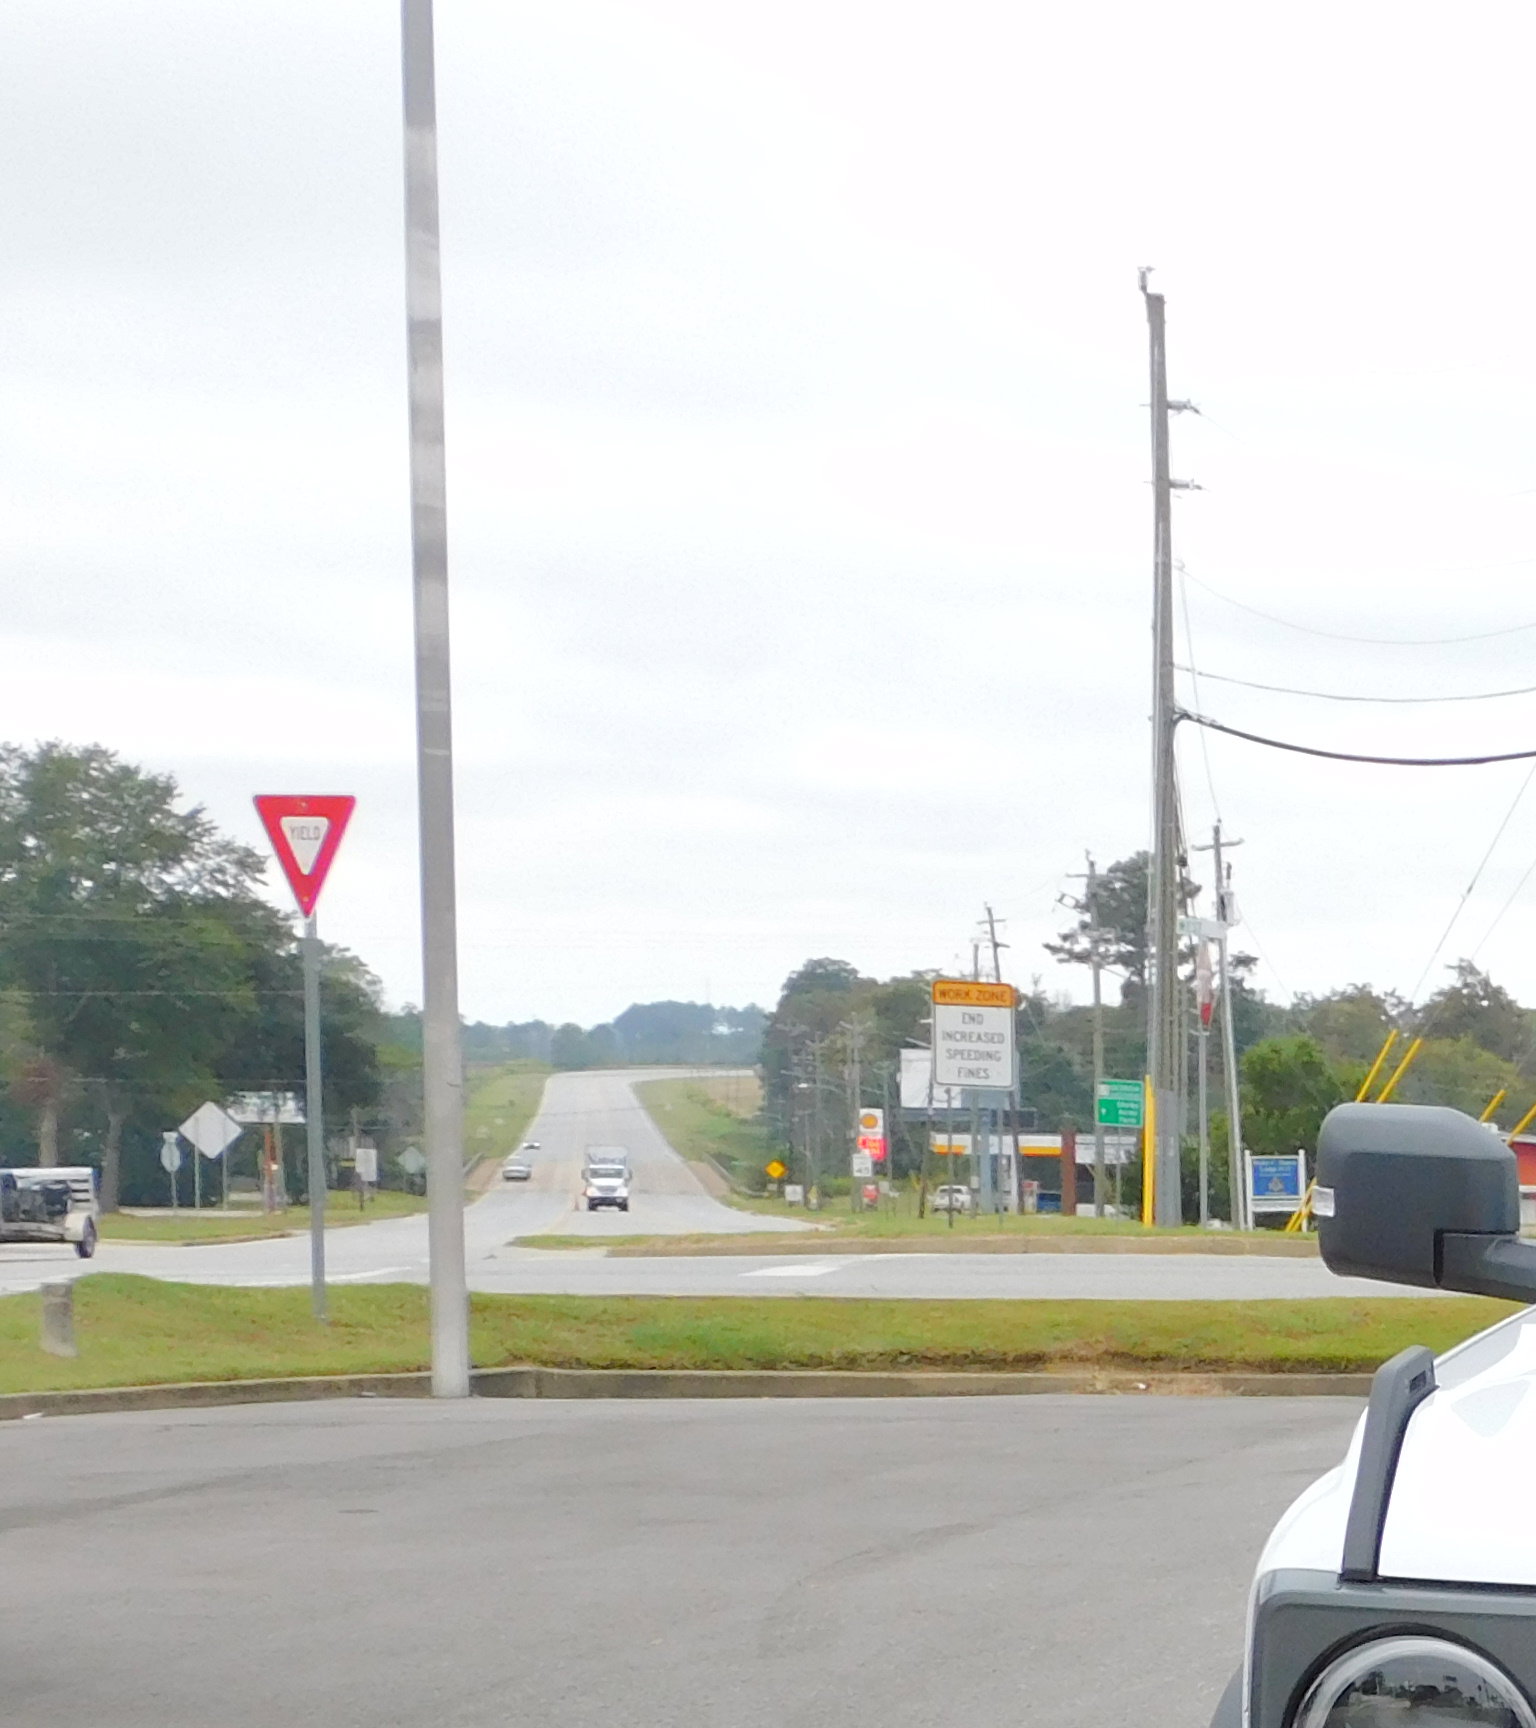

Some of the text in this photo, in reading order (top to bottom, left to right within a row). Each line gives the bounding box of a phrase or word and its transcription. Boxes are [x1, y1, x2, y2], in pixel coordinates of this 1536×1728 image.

[289, 825, 321, 840] YIELD
[939, 989, 1007, 1002] WORK ZONE
[962, 1012, 984, 1025] END
[942, 1030, 1004, 1044] INCREASED
[945, 1048, 1001, 1062] SPEEDING
[957, 1066, 989, 1079] FINES
